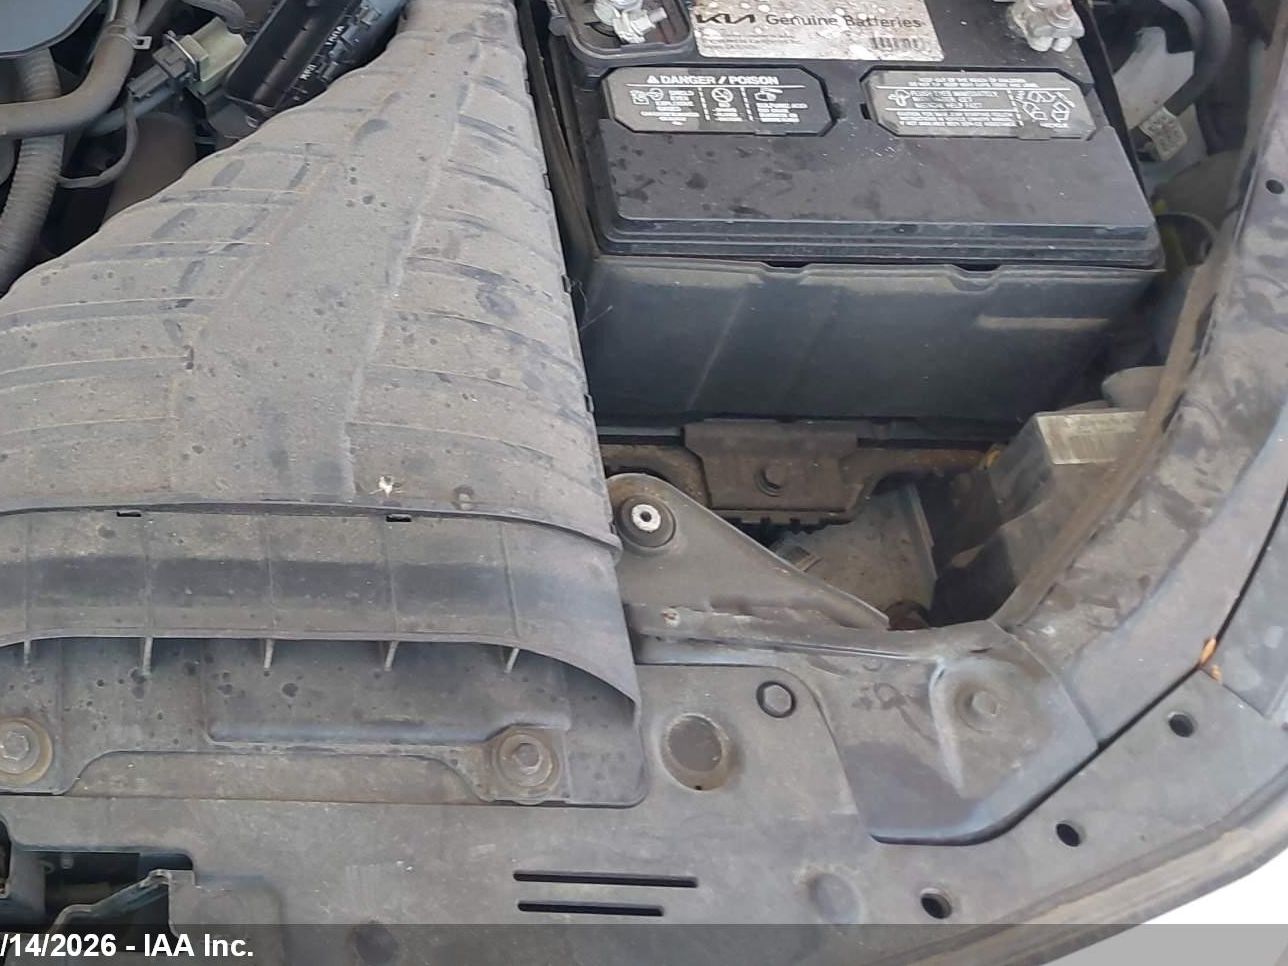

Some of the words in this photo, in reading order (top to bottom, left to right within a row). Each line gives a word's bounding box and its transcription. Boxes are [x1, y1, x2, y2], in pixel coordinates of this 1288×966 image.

[695, 13, 756, 24] KIA
[766, 14, 838, 26] Genuine
[843, 15, 922, 28] Batteries
[660, 75, 716, 85] DANGER
[718, 75, 727, 84] /
[728, 76, 780, 85] POISON
